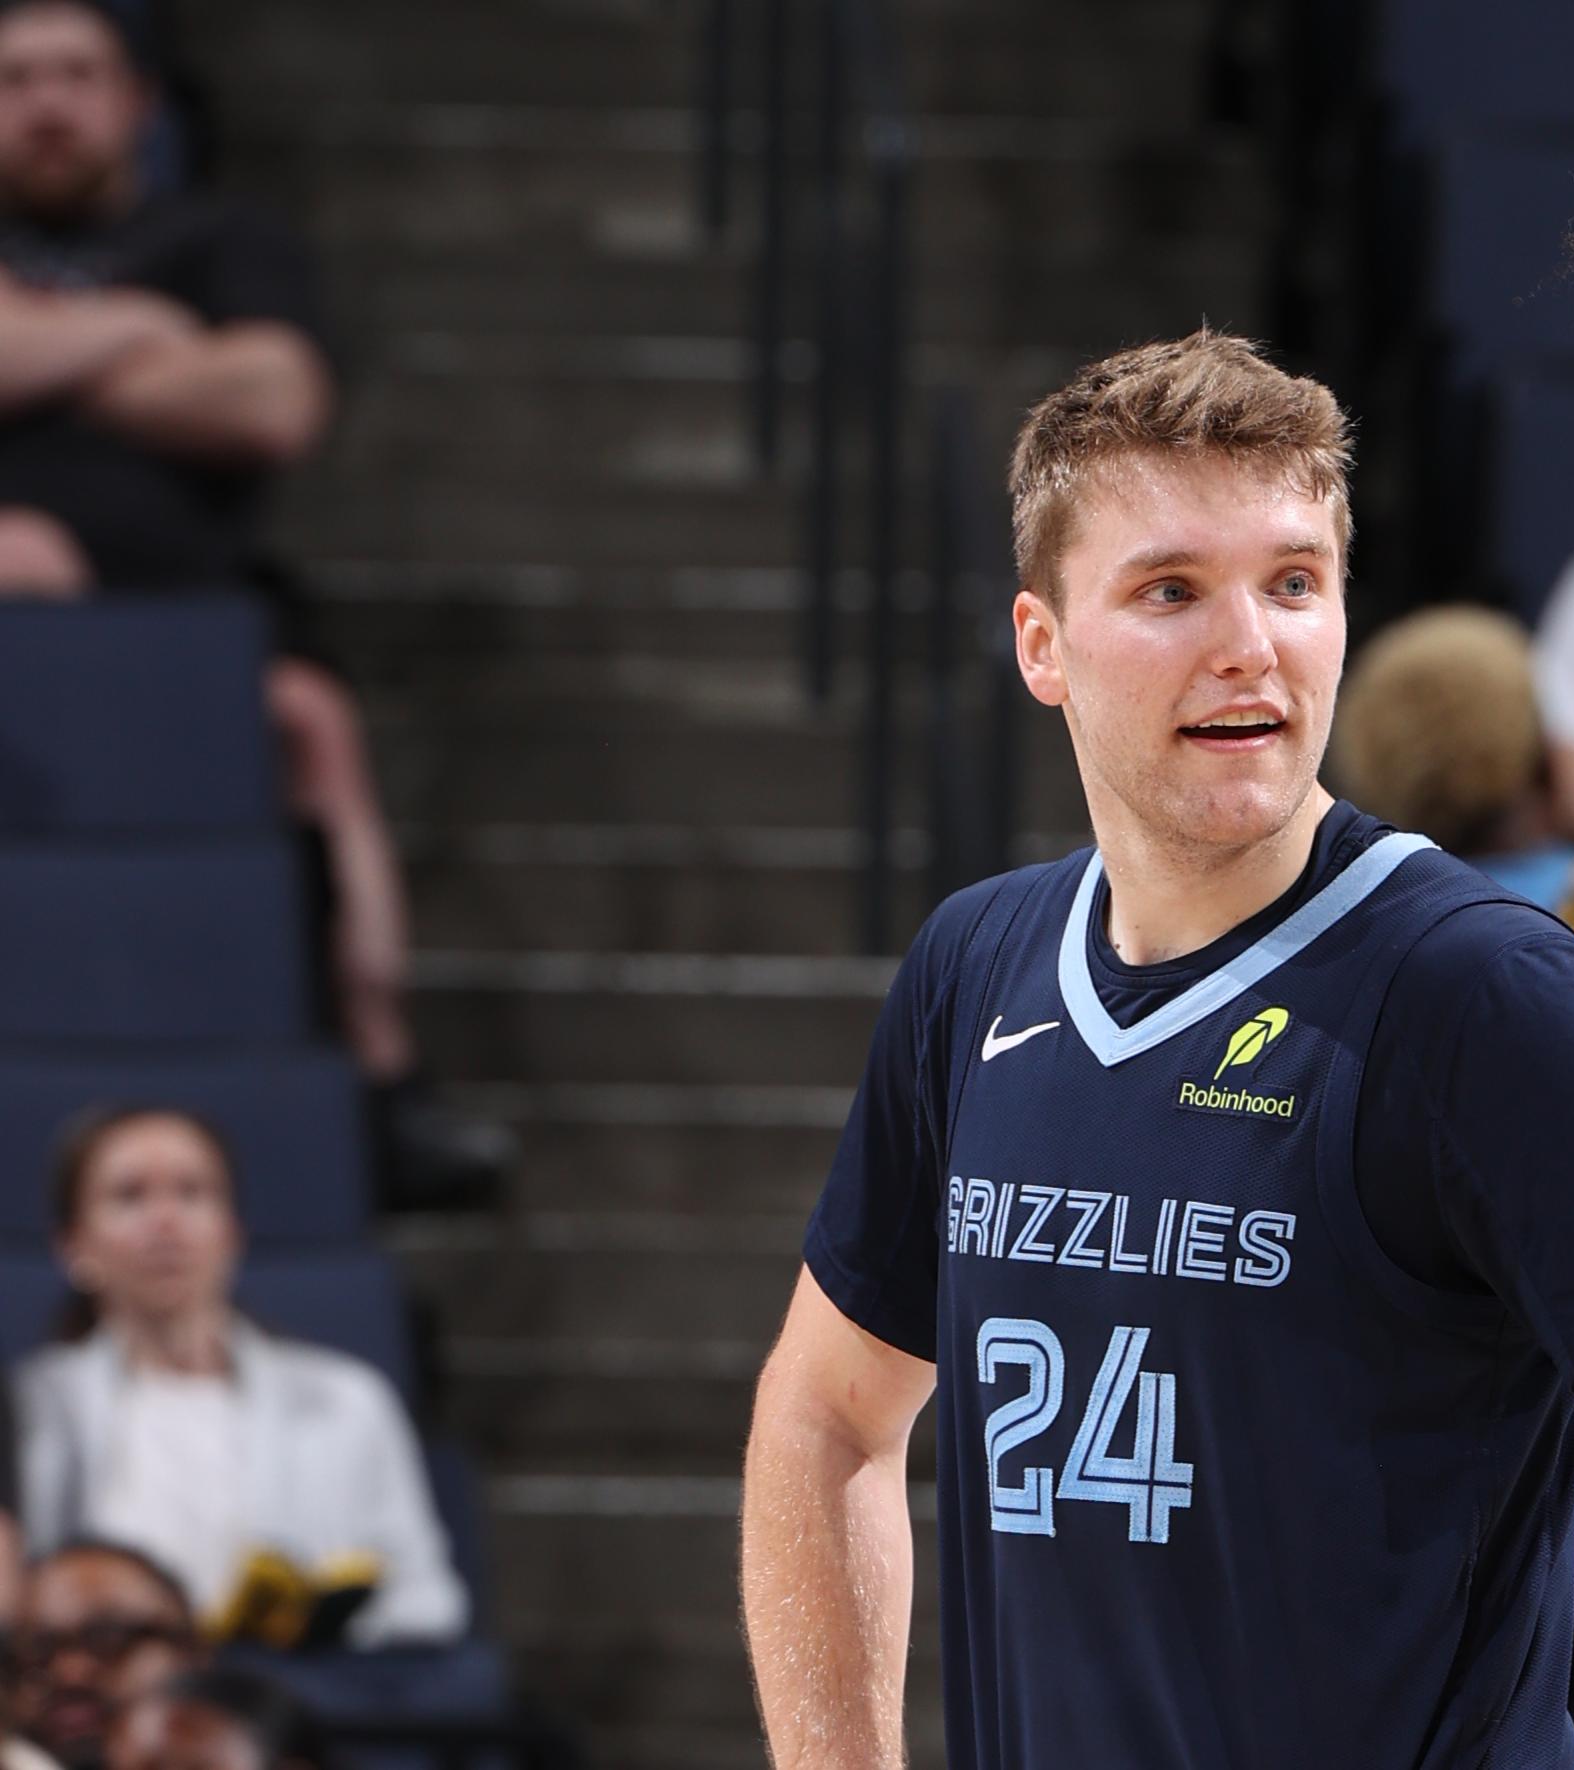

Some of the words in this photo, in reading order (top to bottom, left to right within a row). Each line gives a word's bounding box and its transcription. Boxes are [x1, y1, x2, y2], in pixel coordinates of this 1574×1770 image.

[1178, 1082, 1295, 1118] Robinhood
[947, 1175, 1297, 1288] GRIZZLIES
[976, 1316, 1194, 1544] 24
